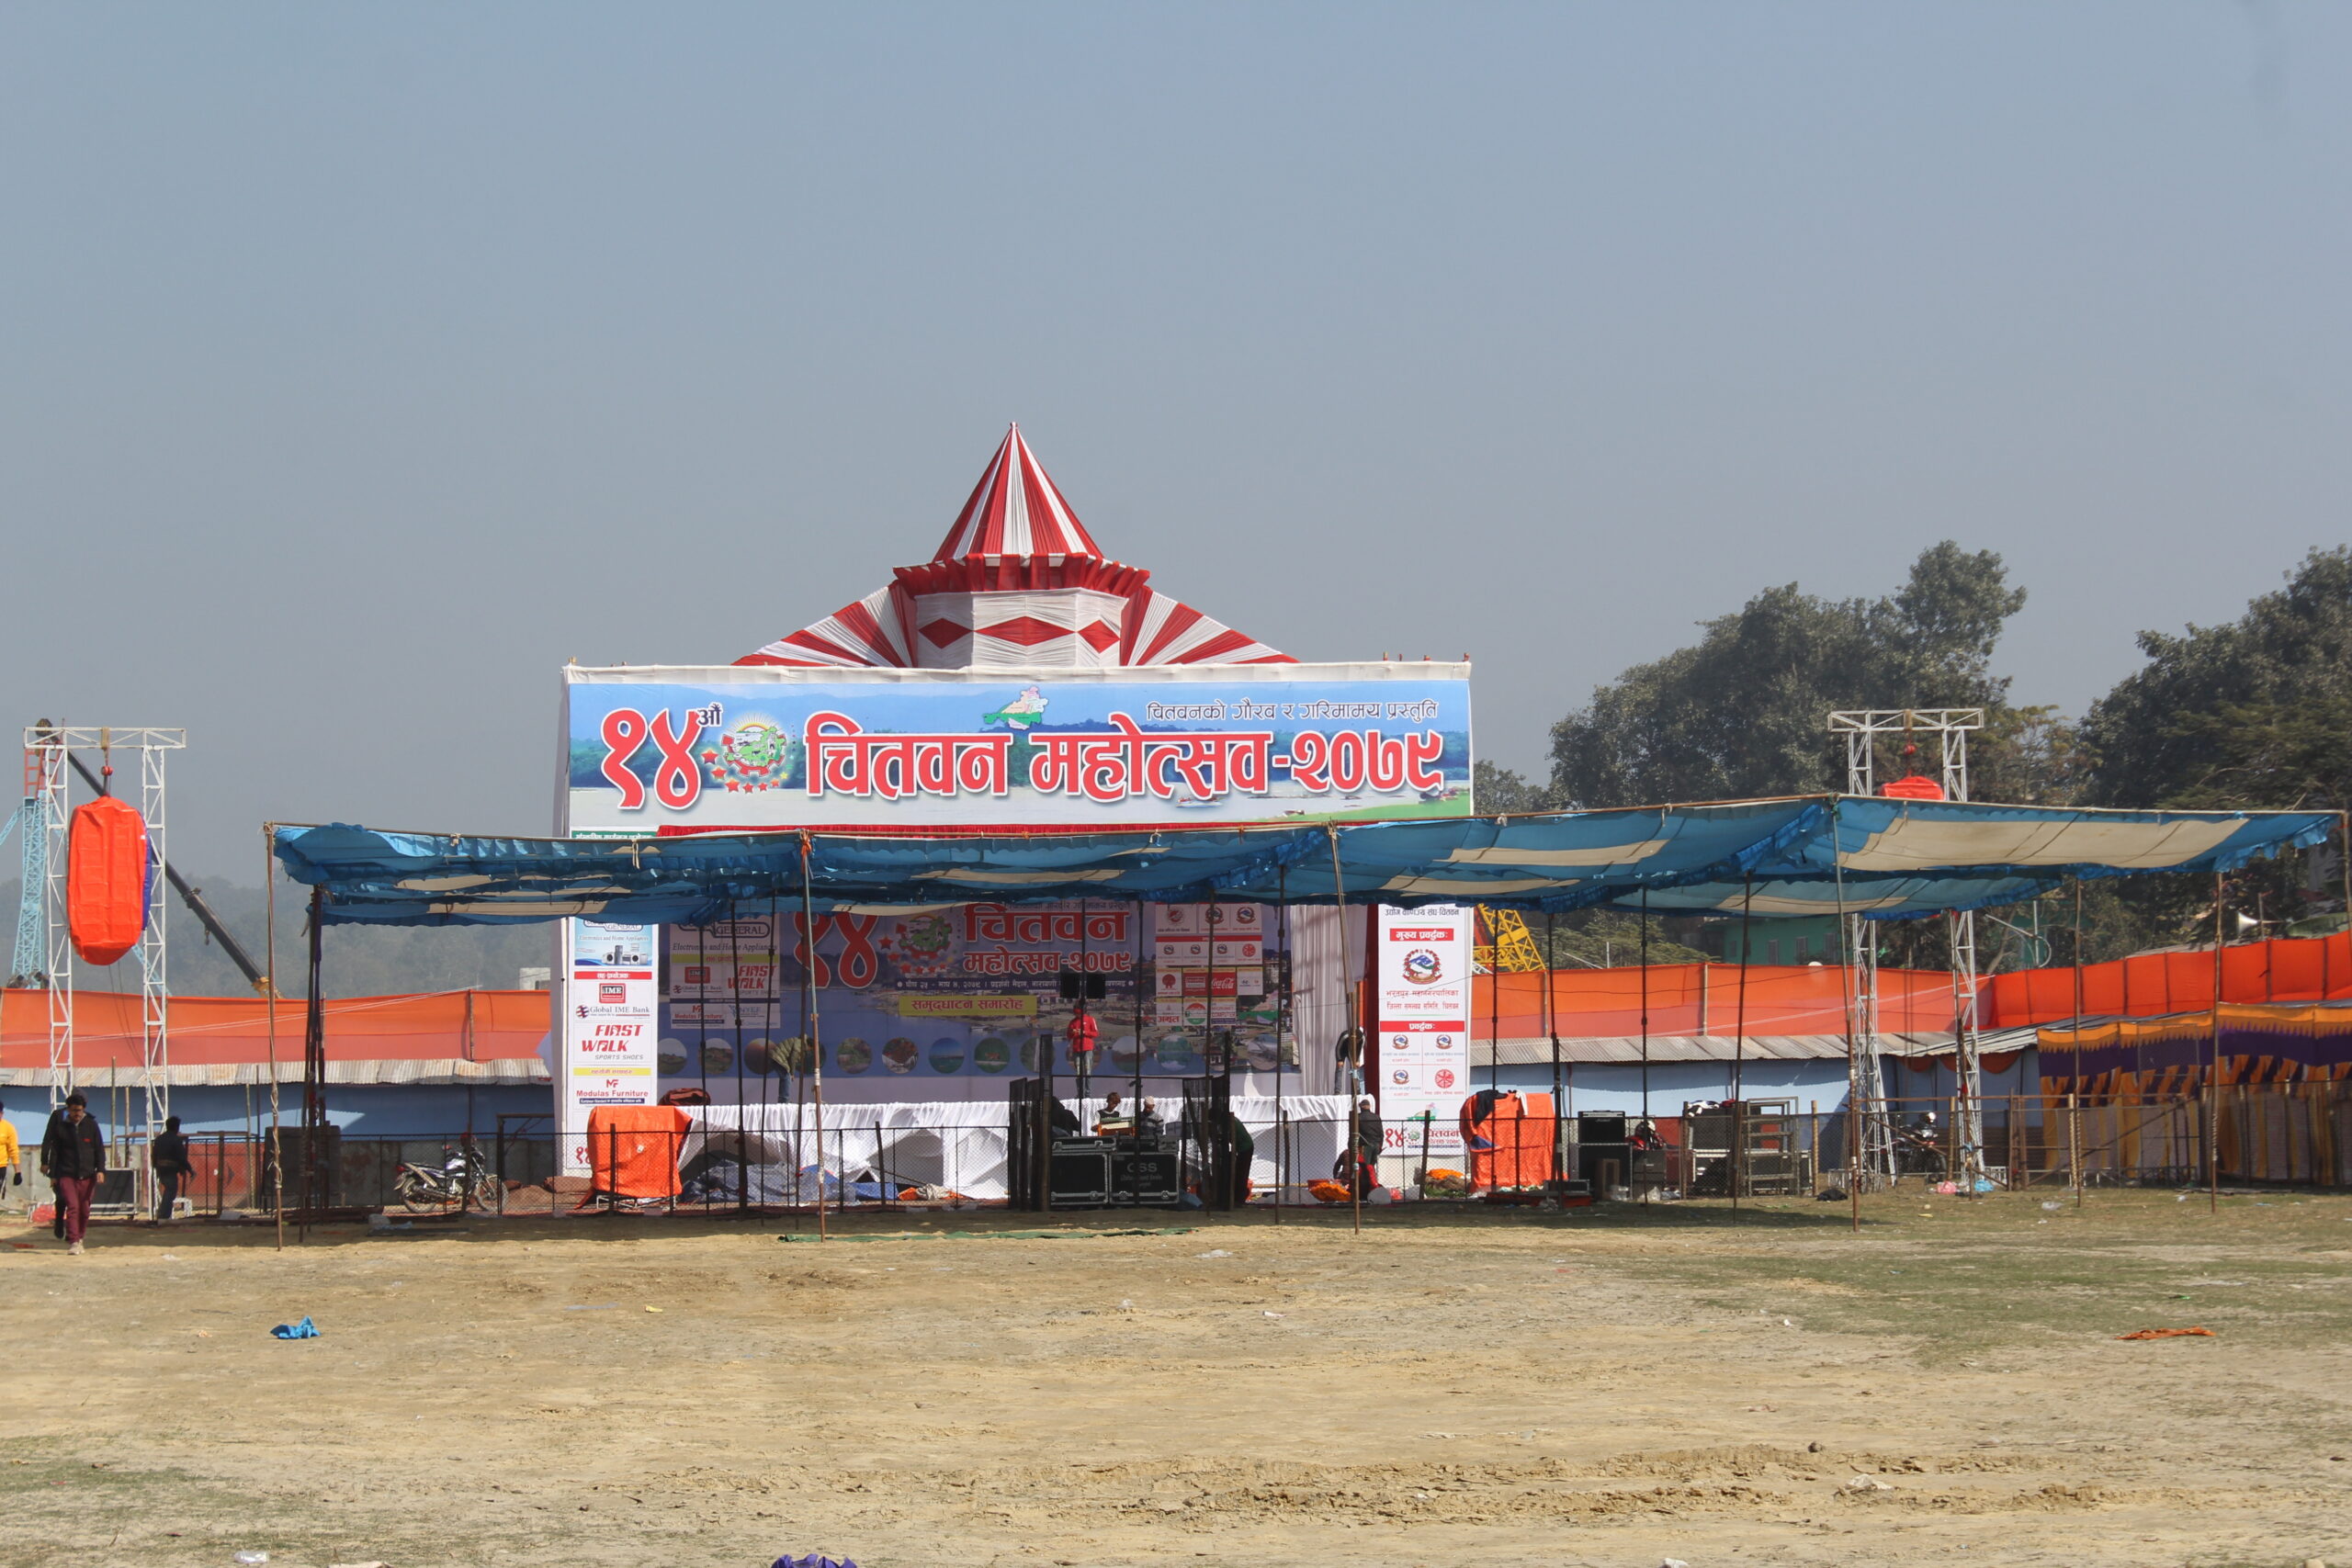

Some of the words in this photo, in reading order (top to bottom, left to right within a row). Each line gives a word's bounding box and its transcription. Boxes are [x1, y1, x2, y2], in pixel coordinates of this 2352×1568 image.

[1147, 700, 1227, 720] चितवनको
[1232, 698, 1275, 720] गौरव
[1283, 704, 1295, 720] र
[1300, 700, 1381, 720] गरिमामय
[1386, 700, 1438, 722] प्रस्तुति
[602, 708, 701, 808] १४
[803, 712, 1012, 799] चितवन
[964, 902, 1130, 943] चितवन
[738, 965, 777, 977] FIRST
[977, 998, 1023, 1010] समारोह
[594, 1024, 644, 1036] FIRST
[582, 1040, 629, 1052] WALK
